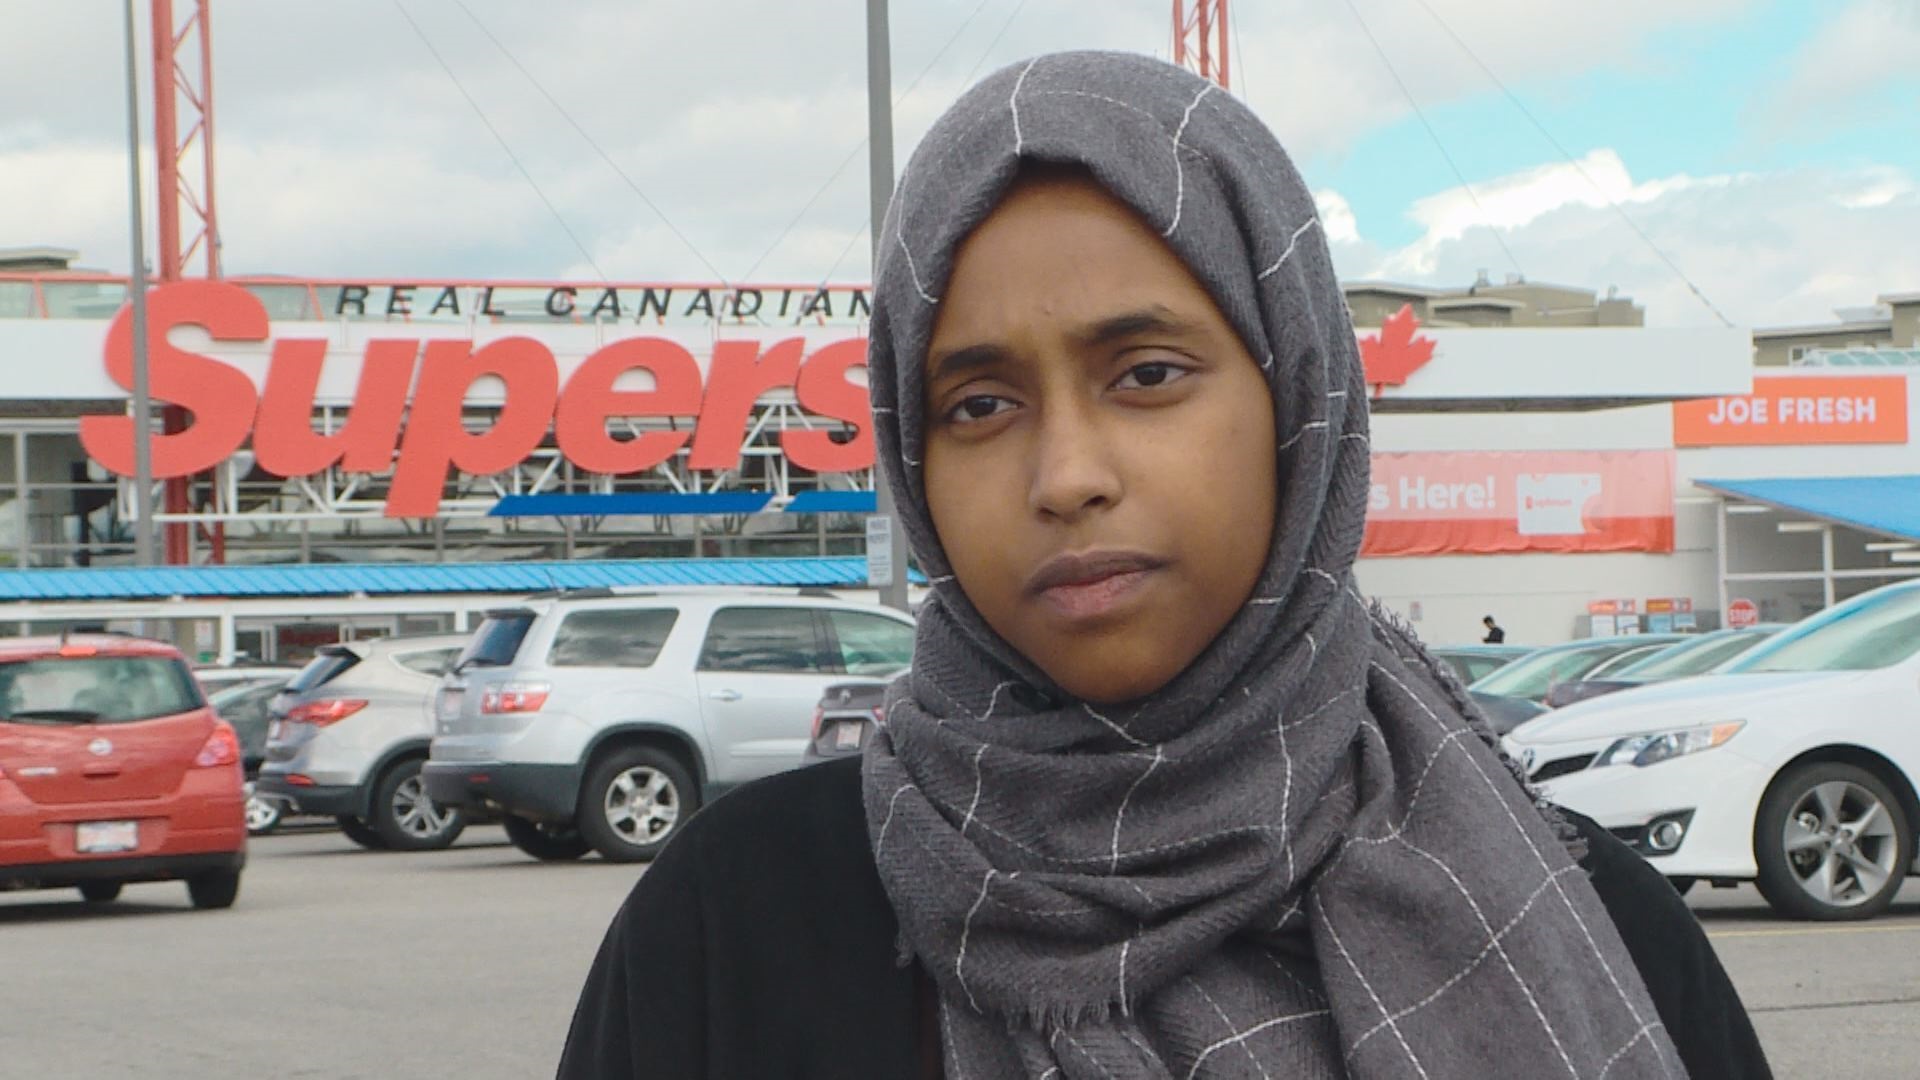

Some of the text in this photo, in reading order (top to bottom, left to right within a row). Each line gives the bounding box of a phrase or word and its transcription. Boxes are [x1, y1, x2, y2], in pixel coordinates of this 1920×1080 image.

[335, 285, 505, 315] REAL
[1708, 397, 1876, 424] JOE FRESH
[1399, 475, 1496, 510] Here!
[1728, 608, 1760, 623] STOP
